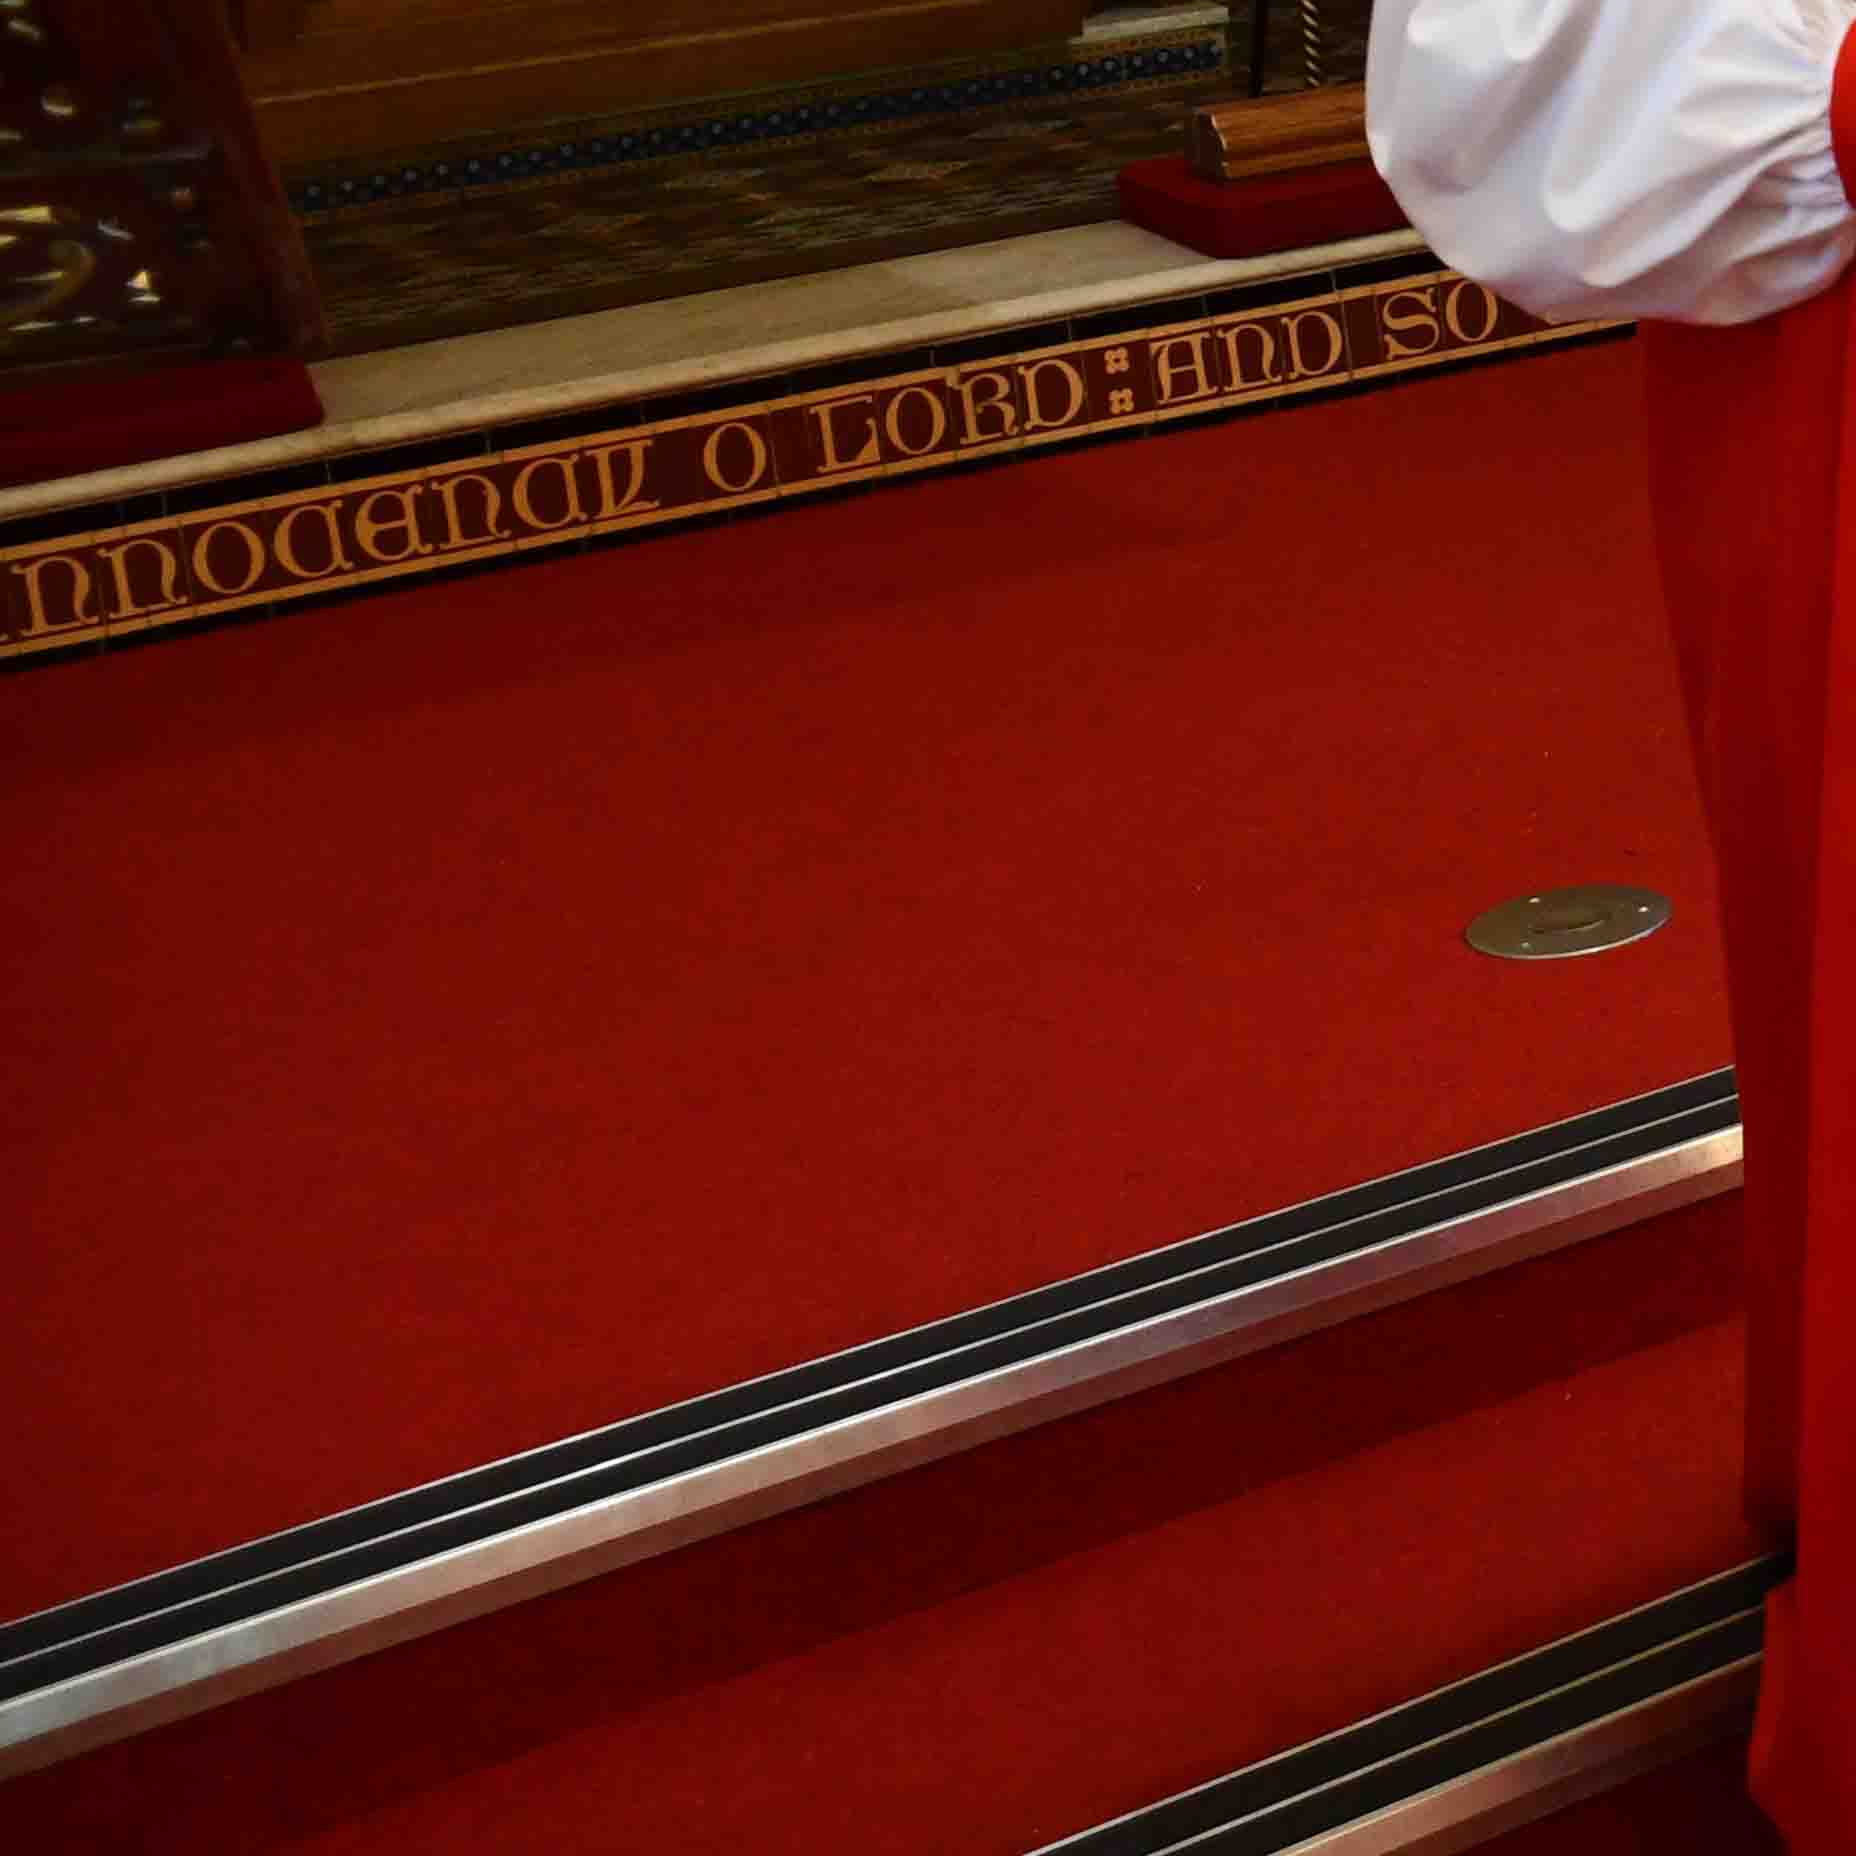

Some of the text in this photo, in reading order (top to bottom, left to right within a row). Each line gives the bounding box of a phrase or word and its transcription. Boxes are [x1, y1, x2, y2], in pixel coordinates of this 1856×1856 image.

[0, 440, 660, 641] NNOCENCY
[703, 421, 768, 492] O
[811, 356, 1085, 474] LORD
[1150, 310, 1342, 406] AND
